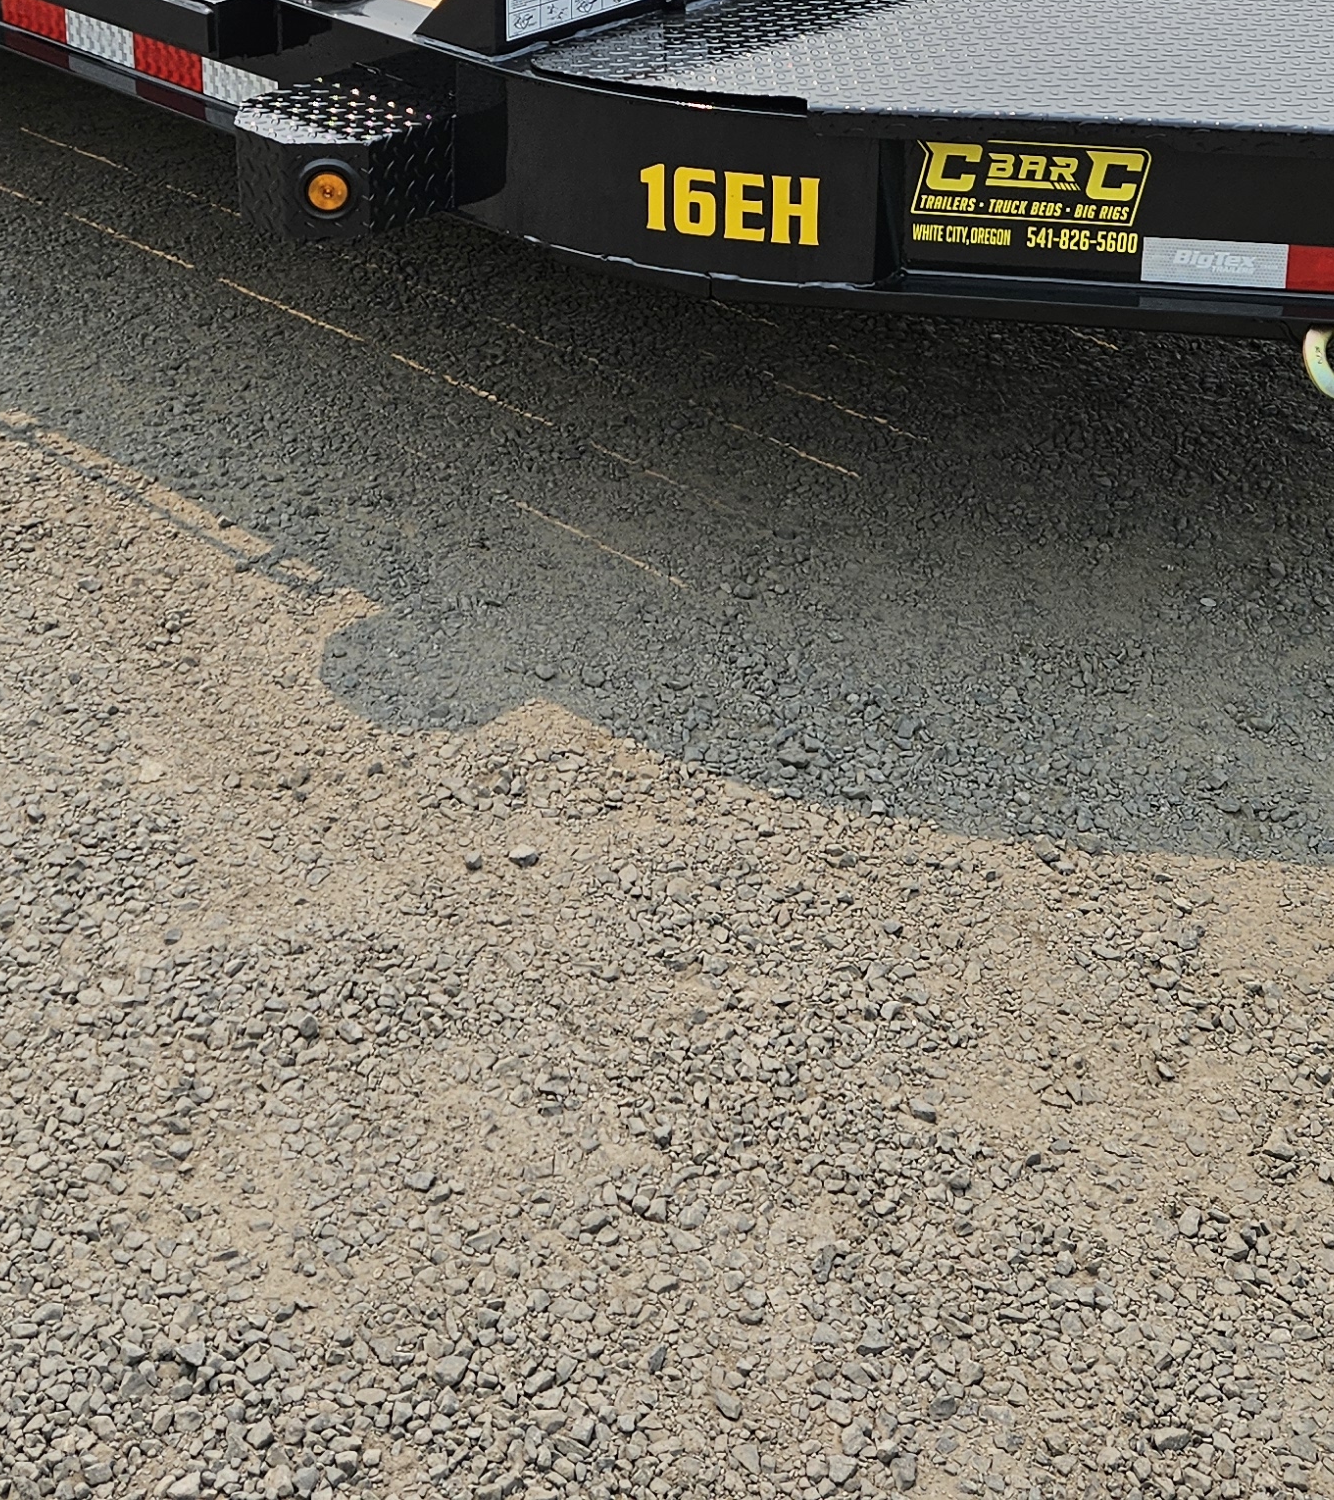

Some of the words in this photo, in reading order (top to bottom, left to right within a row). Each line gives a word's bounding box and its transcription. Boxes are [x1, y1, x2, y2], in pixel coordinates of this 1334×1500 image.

[926, 141, 984, 192] C
[987, 152, 1080, 183] BAR
[1085, 150, 1146, 202] C
[640, 163, 820, 246] 16EH
[919, 194, 976, 212] TRAILERS
[988, 198, 1027, 215] TRUCK
[1030, 201, 1063, 217] BEDS
[1074, 203, 1095, 219] BIG
[1099, 205, 1130, 221] RIGS
[912, 223, 944, 242] WHITE
[1027, 226, 1138, 254] 541-826-5600
[1173, 249, 1256, 269] BigTex
